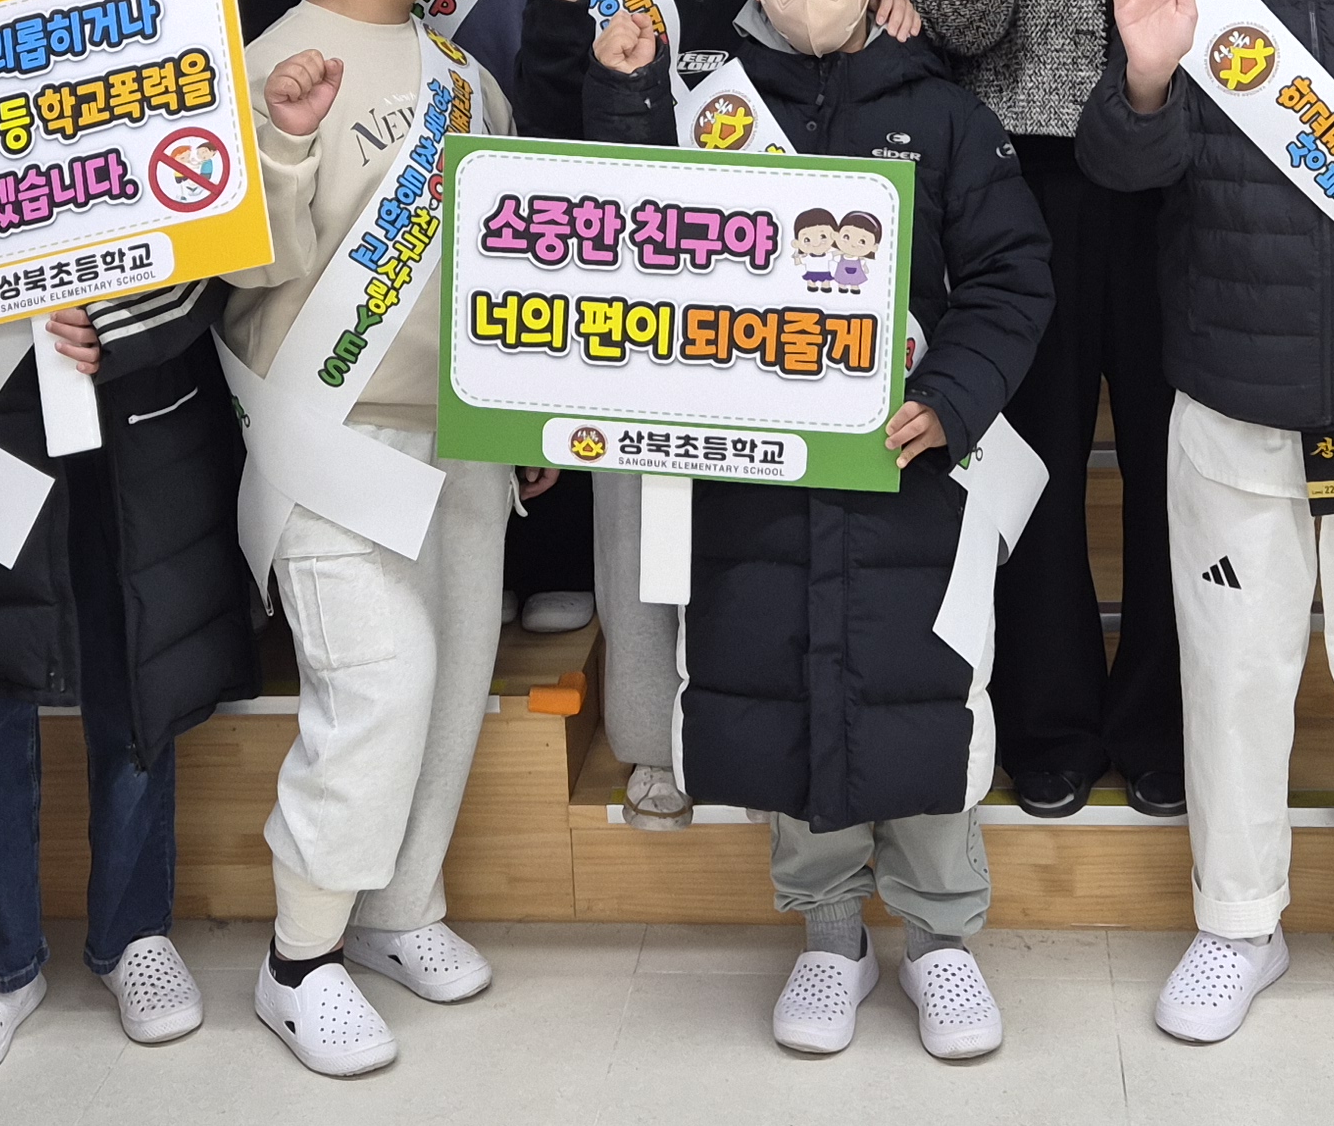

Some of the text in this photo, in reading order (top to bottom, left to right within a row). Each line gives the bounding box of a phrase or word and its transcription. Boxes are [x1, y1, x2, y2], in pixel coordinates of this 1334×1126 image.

[34, 47, 217, 138] 학교폭력을
[349, 79, 453, 276] 상북초등학교
[870, 148, 922, 164] EIDER
[481, 193, 779, 271] 소중한 친구야
[0, 269, 157, 314] SANGBUK ELEMENTARY SCHOOL
[471, 291, 878, 376] 너의 편이 되어줄게
[618, 430, 785, 466] 상북초등학교
[618, 457, 785, 477] SANGBUK ELEMENTARY SCHOOL
